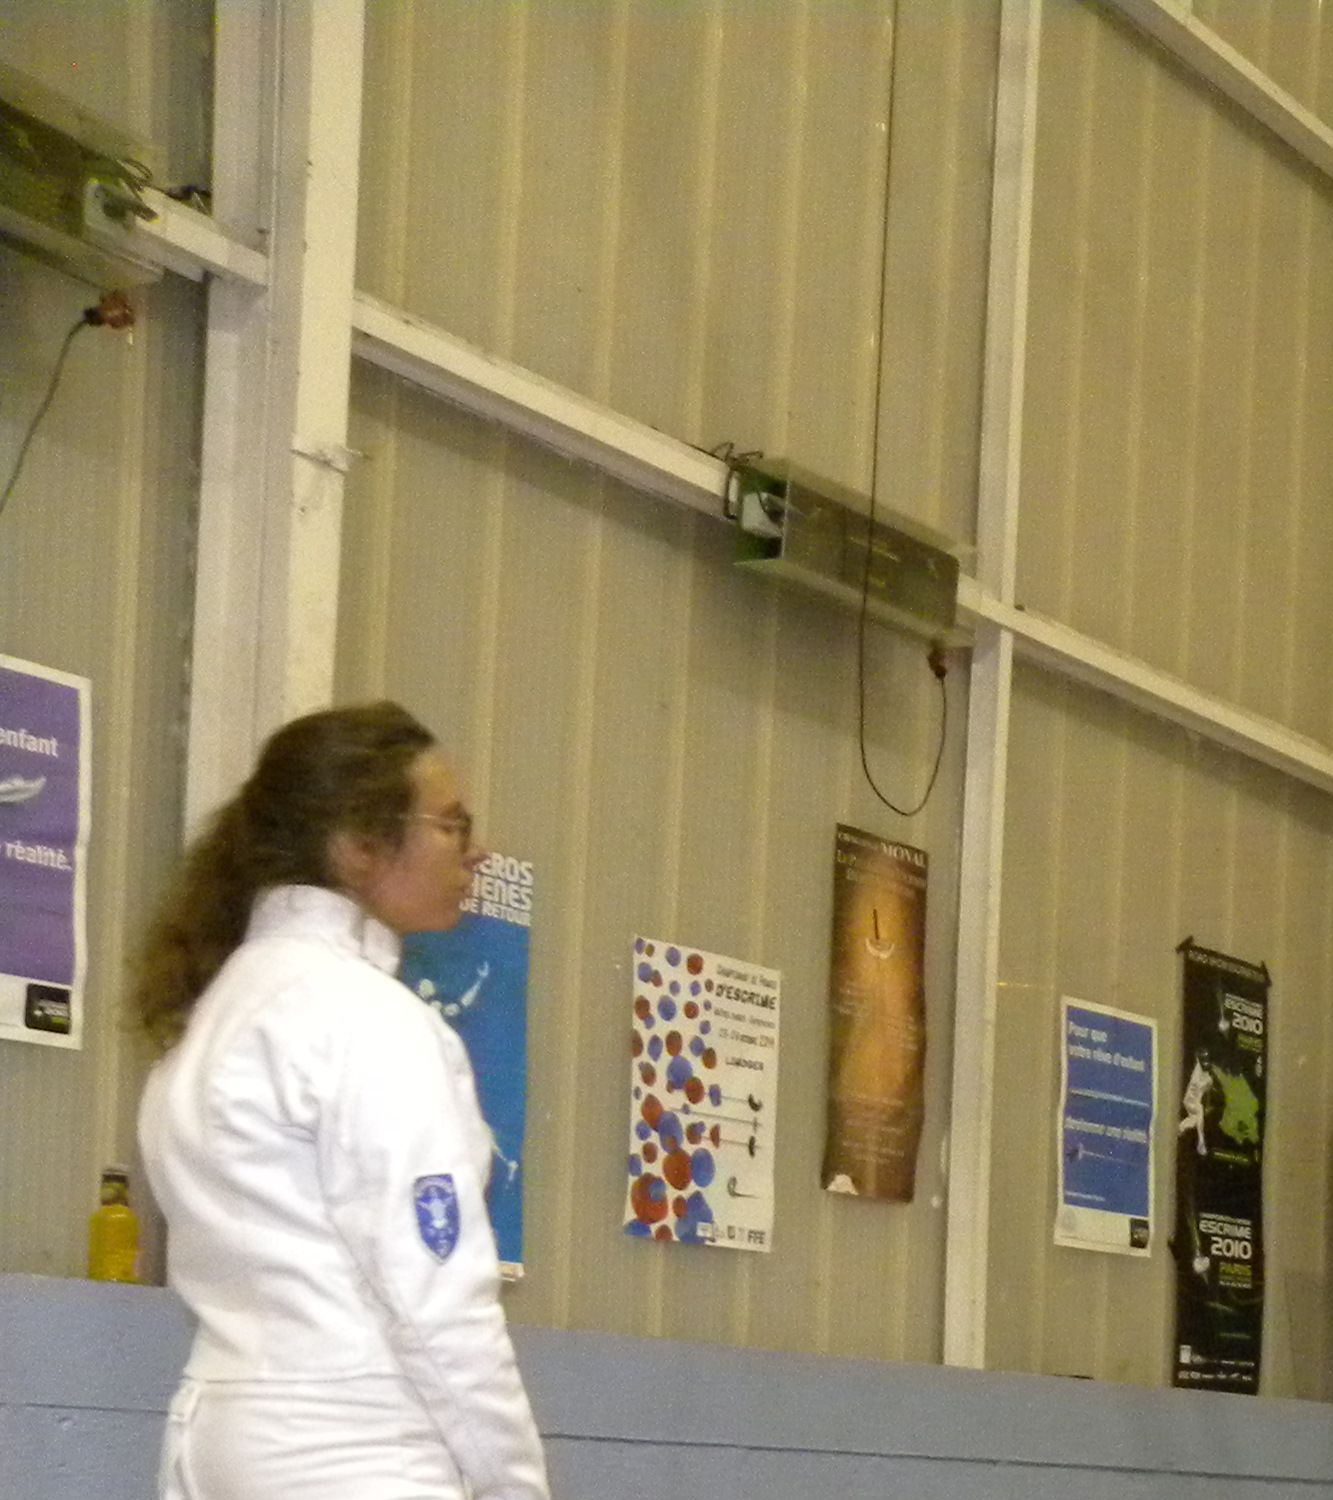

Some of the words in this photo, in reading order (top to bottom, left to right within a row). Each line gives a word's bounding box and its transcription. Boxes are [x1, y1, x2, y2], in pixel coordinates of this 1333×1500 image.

[1232, 1011, 1263, 1035] 2010
[1199, 1219, 1252, 1240] ESCRIME
[1210, 1236, 1252, 1260] 2010
